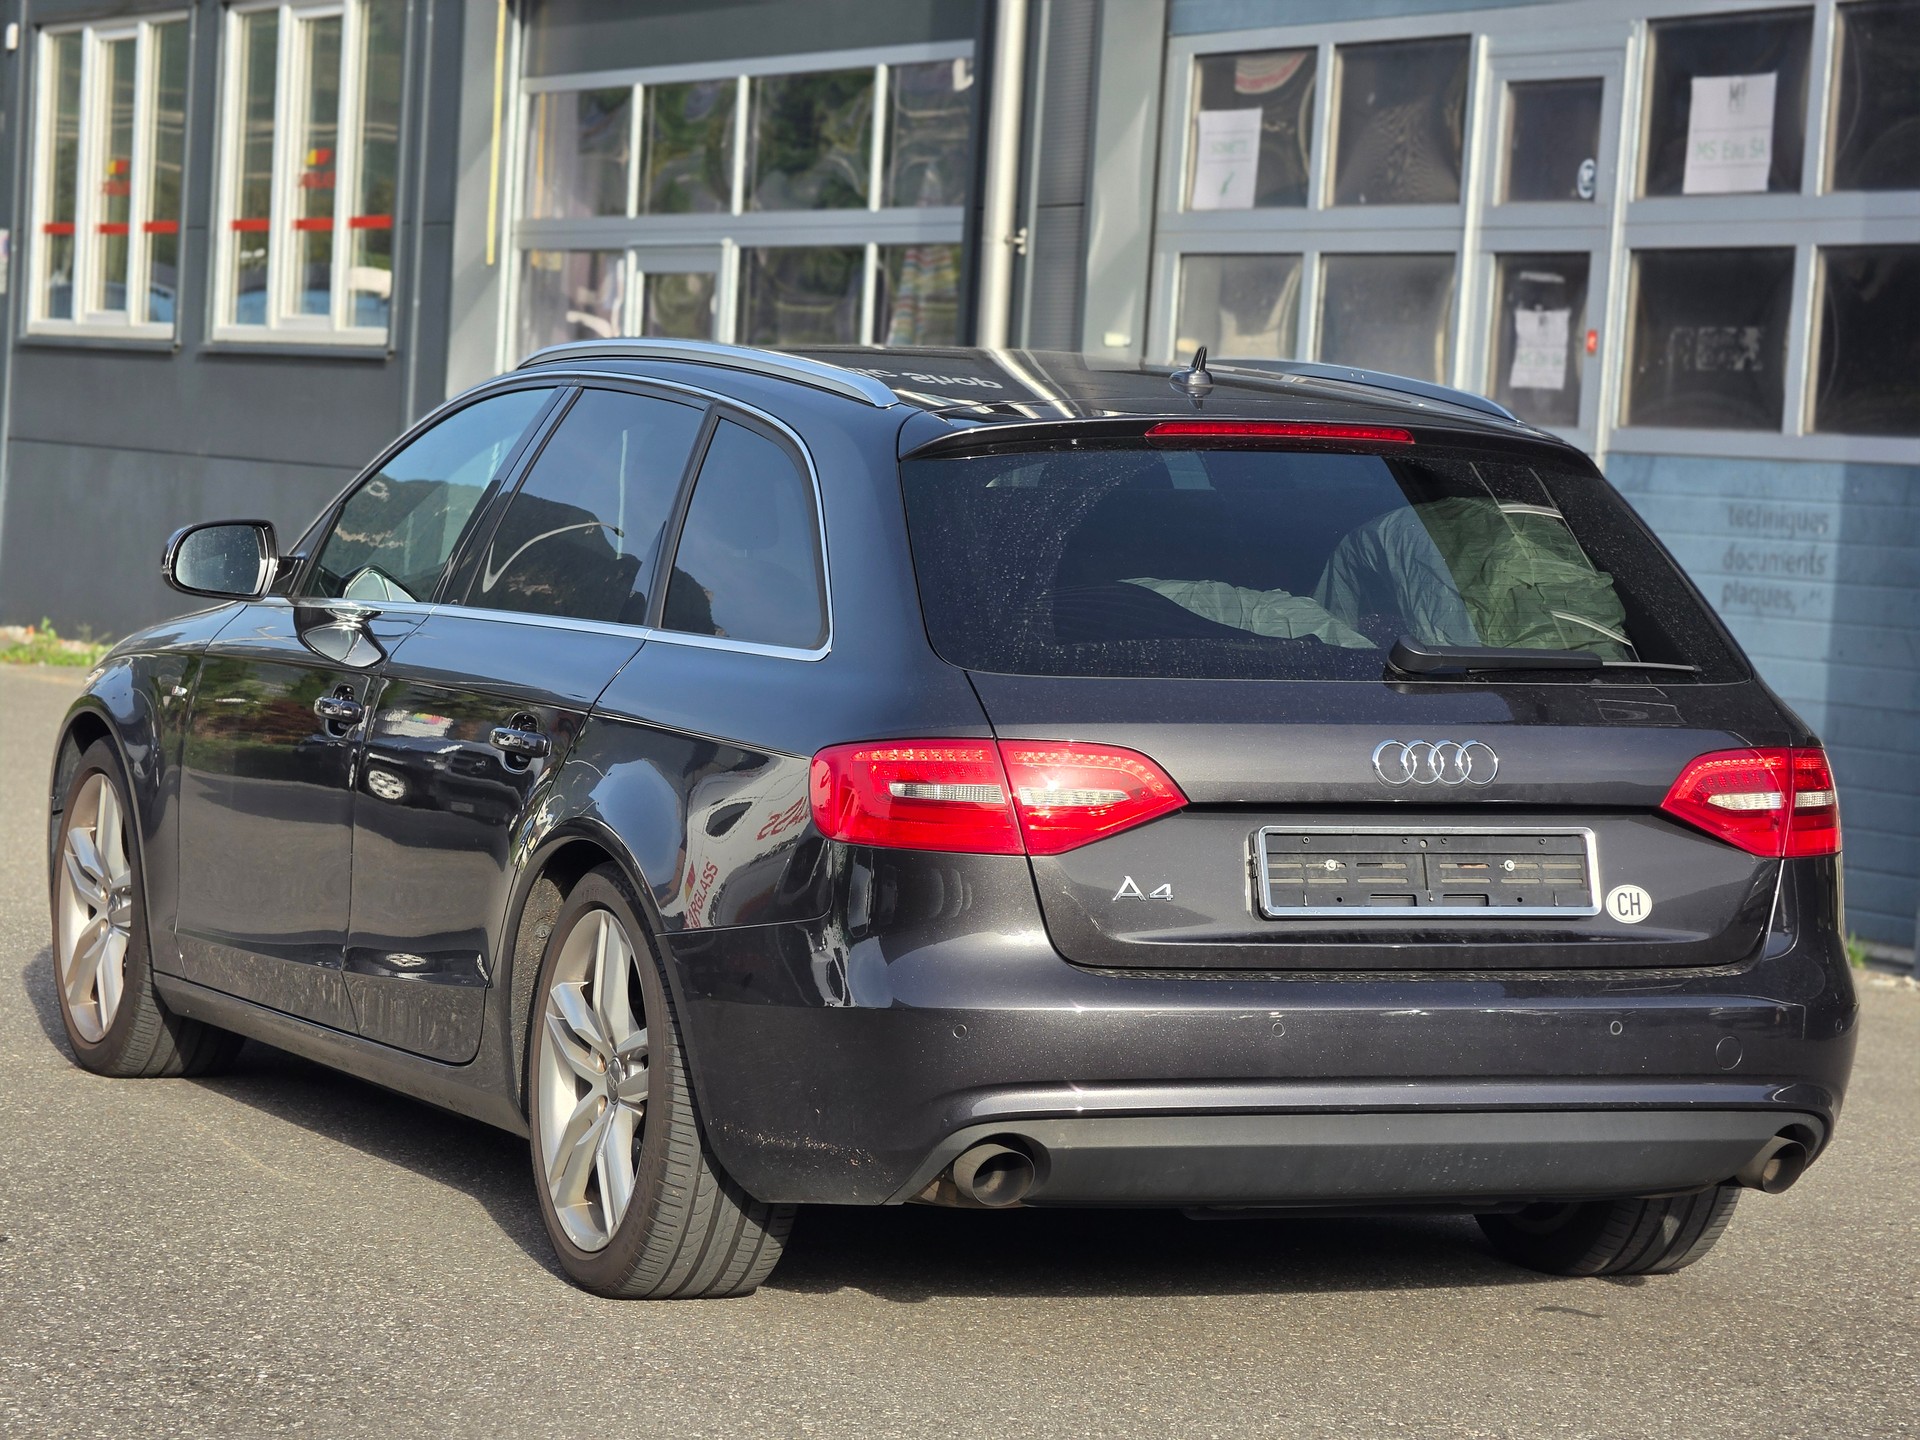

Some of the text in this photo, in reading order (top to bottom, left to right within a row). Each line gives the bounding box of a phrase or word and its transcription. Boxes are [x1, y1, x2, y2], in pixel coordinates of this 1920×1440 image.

[1727, 503, 1829, 539] techniques
[1722, 541, 1828, 576] documents
[1112, 875, 1174, 902] A4
[1617, 892, 1641, 916] CH
